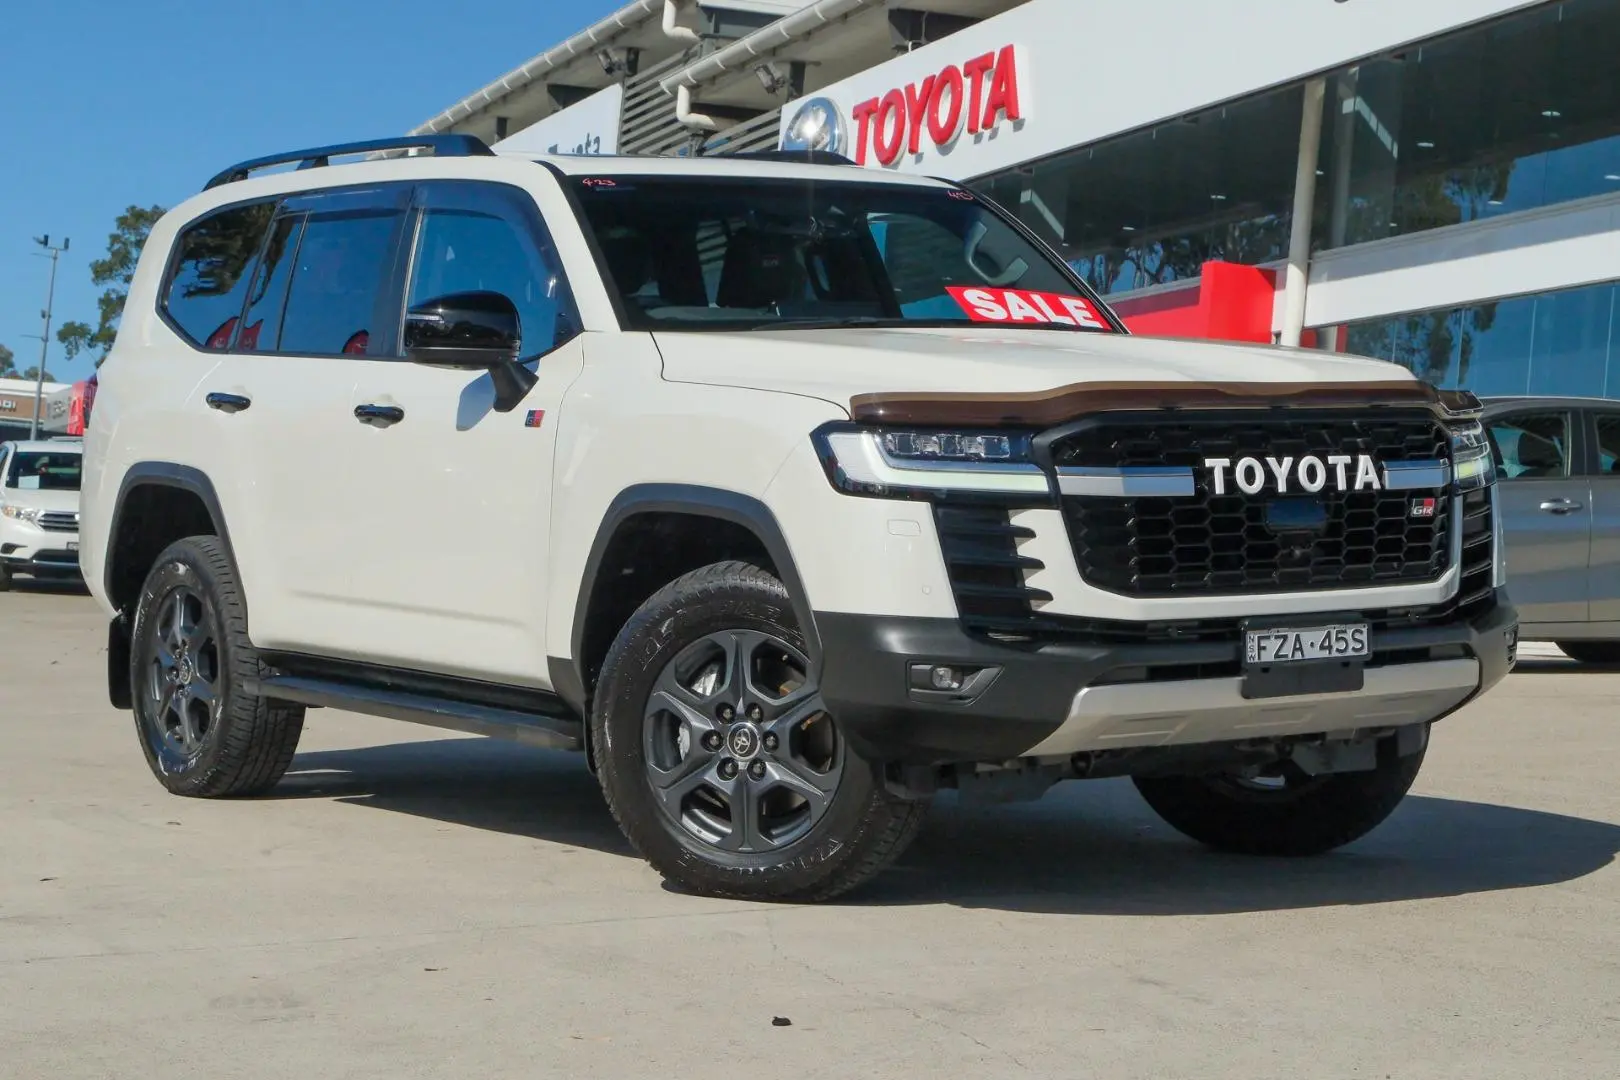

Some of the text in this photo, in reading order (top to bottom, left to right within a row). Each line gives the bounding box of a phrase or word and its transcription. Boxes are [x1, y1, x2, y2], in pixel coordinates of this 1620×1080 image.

[852, 43, 1019, 166] TOYOTA
[963, 289, 1103, 328] SALE
[1205, 454, 1381, 494] TOYOTA
